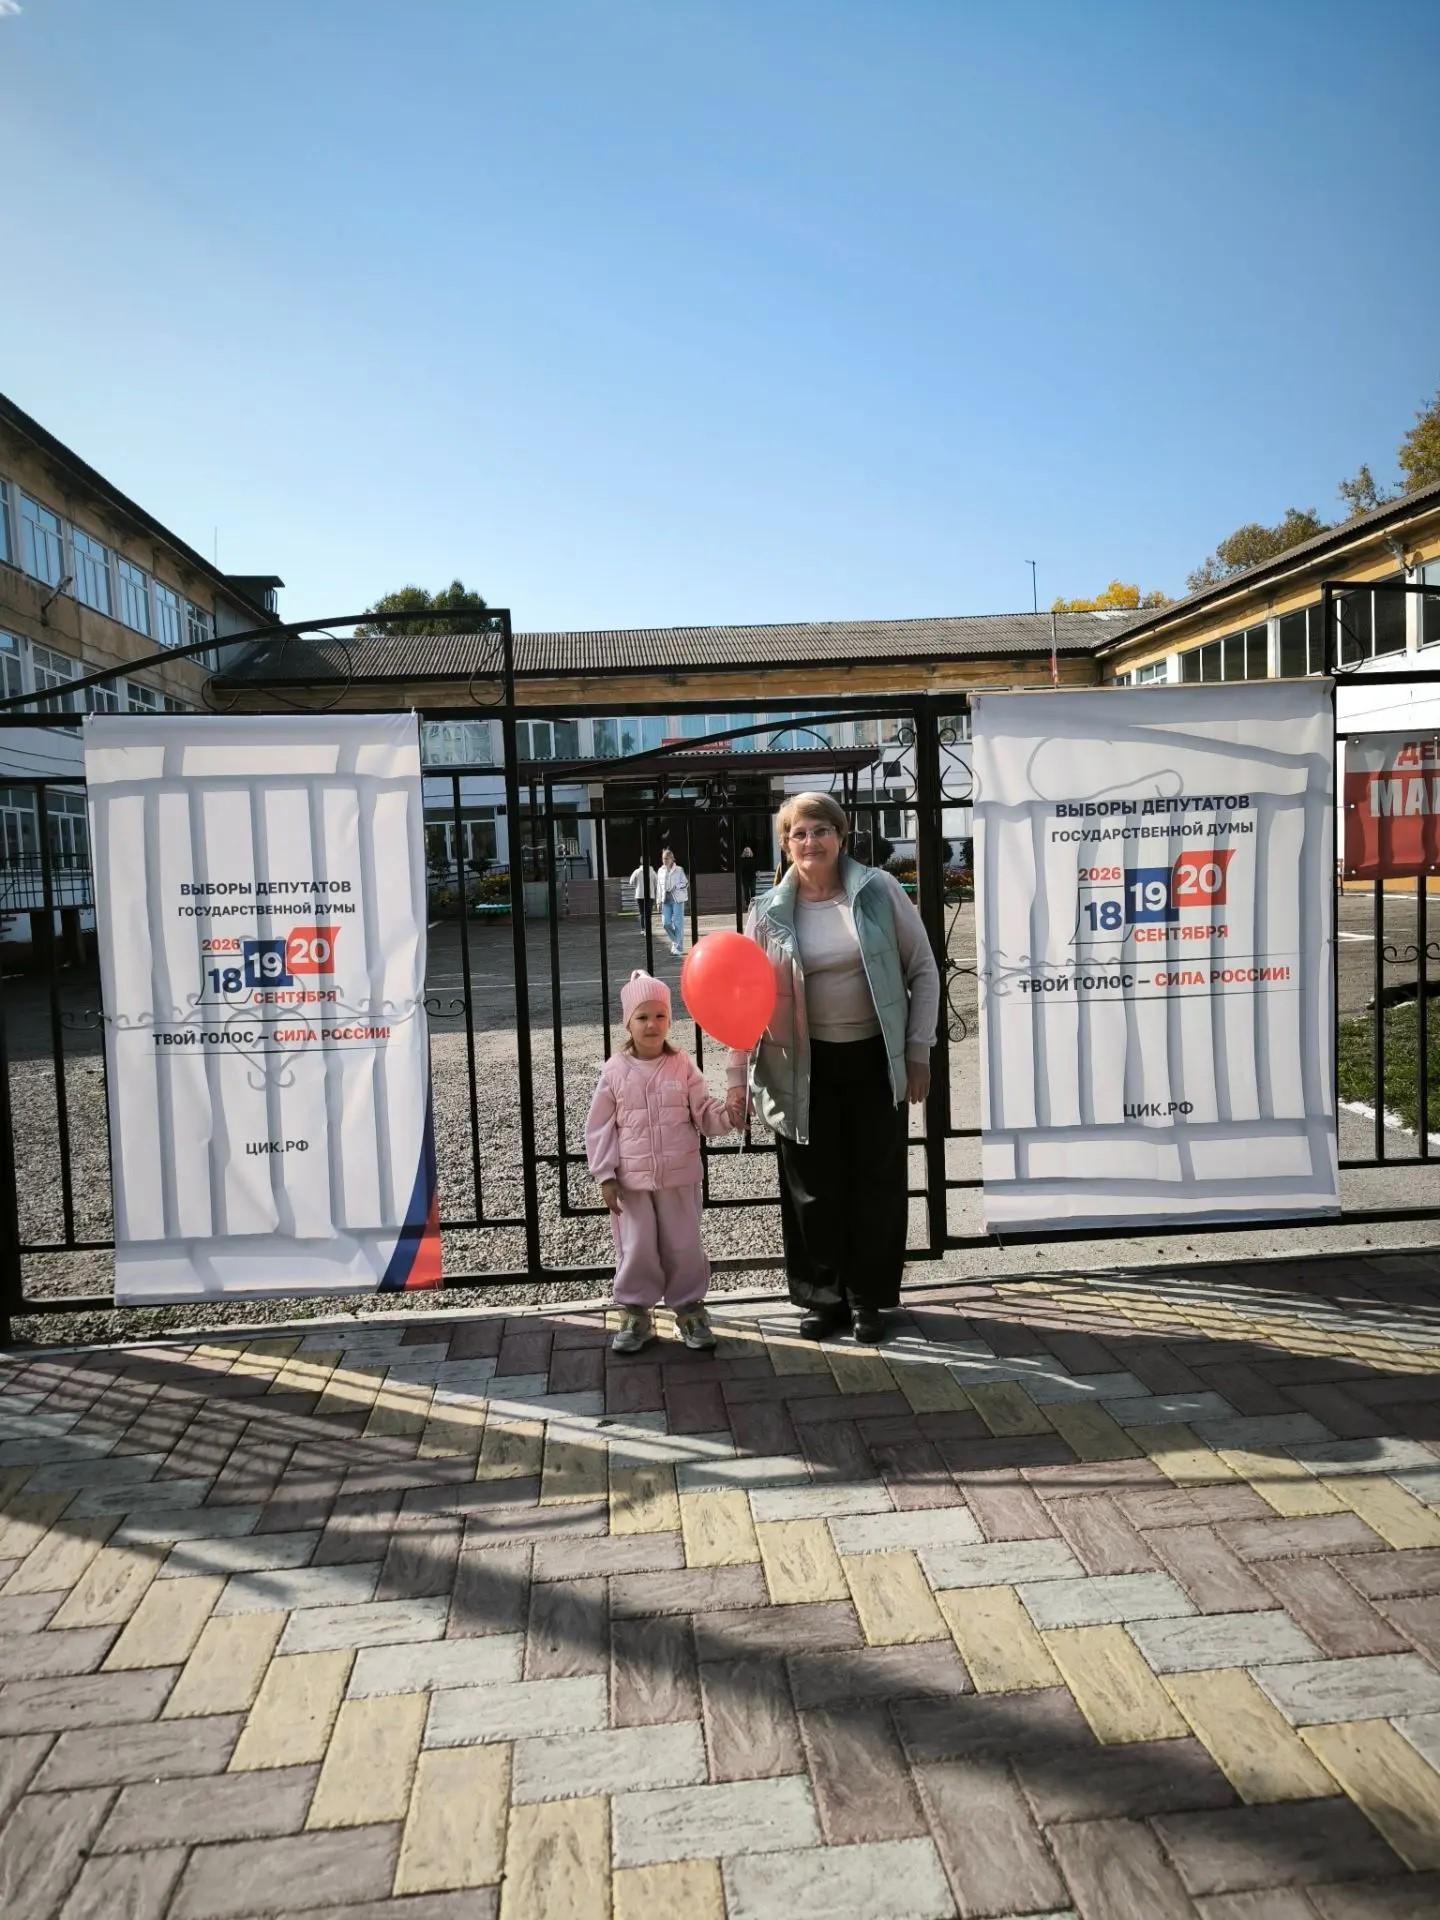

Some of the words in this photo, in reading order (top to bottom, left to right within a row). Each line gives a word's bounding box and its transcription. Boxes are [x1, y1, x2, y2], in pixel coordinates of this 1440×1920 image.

[1398, 741, 1440, 766] ДЕ
[1055, 801, 1137, 818] ВЫБОРЫ
[1141, 795, 1250, 816] ДЕПУТАТОВ
[1051, 822, 1204, 843] ГОСУДАРСТВЕННОЙ
[1206, 821, 1254, 836] ДУМЫ
[1078, 867, 1121, 882] 2026
[180, 882, 252, 896] ВЫБОРЫ
[255, 880, 352, 897] ДЕПУТАТОВ
[1084, 900, 1123, 931] 18
[1129, 881, 1166, 912] 19
[1177, 863, 1224, 894] 20
[178, 902, 312, 917] ГОСУДАРСТВЕННОЙ
[314, 903, 356, 915] ДУМЫ
[1134, 925, 1228, 943] СЕНТЯБРЯ
[202, 938, 241, 951] 2026
[207, 968, 243, 993] 18
[248, 951, 283, 978] 19
[290, 938, 331, 964] 20
[1020, 975, 1069, 993] ТВОЙ
[1073, 974, 1133, 991] ГОЛОС
[1155, 970, 1205, 987] СИЛА
[1210, 967, 1291, 985] РОССИИ!
[253, 990, 337, 1004] СЕНТЯБРЯ
[152, 1030, 196, 1046] ТВОЙ
[200, 1031, 254, 1044] ГОЛОС
[273, 1028, 318, 1042] СИЛА
[321, 1027, 391, 1041] РОССИИ!
[1123, 1101, 1194, 1118] ЦИК.РФ
[245, 1139, 309, 1155] ЦИК.РФ
